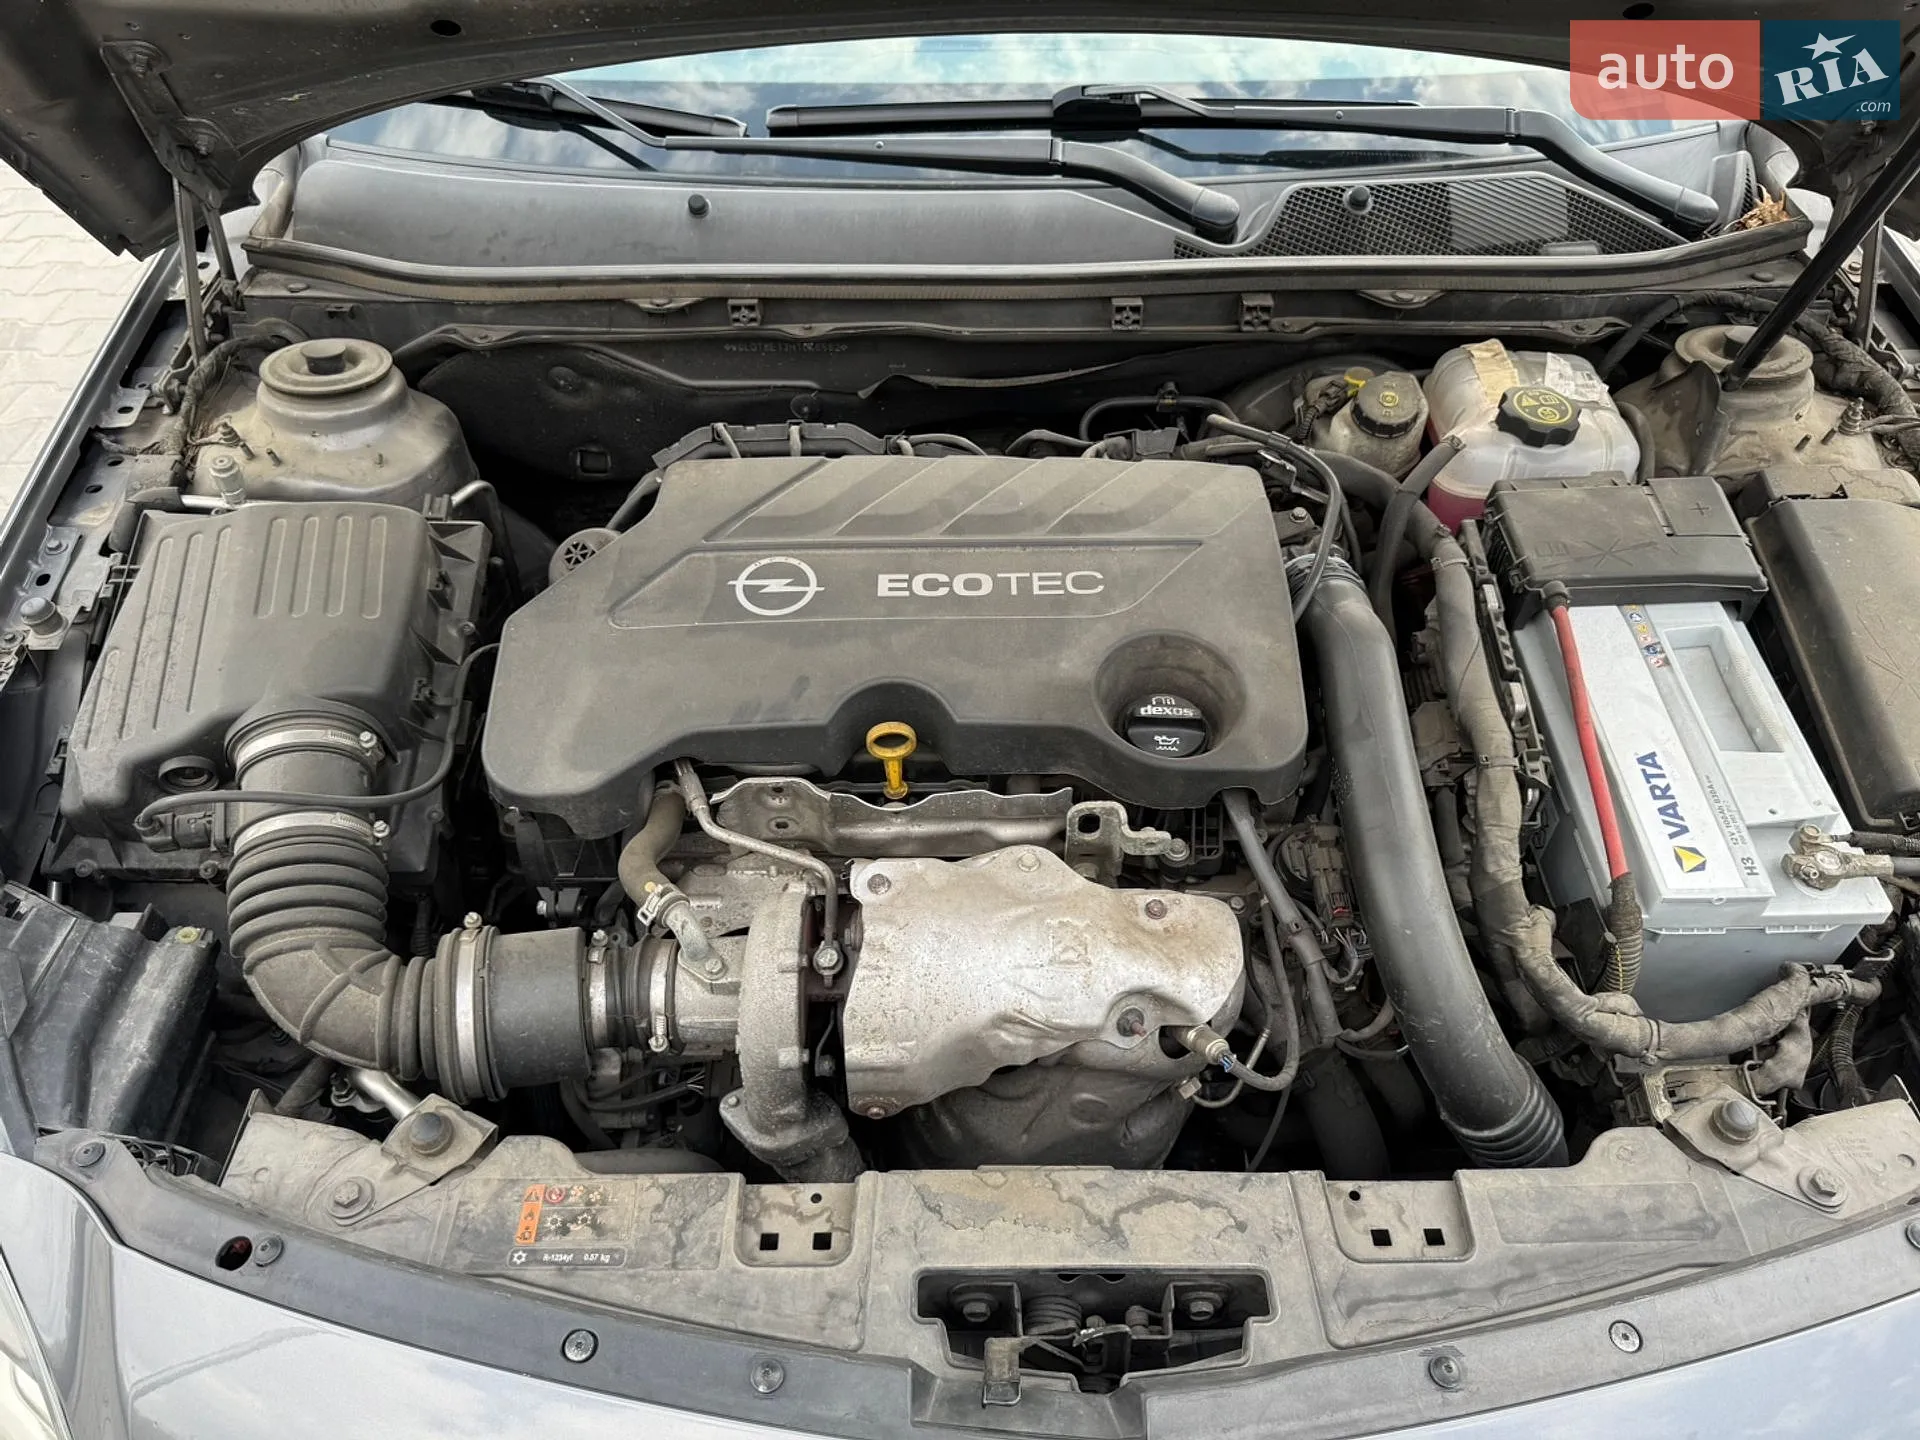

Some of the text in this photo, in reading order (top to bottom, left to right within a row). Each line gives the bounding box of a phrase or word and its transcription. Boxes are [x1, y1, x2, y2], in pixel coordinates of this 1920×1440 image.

[877, 571, 1105, 597] ECOTEC
[1140, 704, 1194, 717] dexos
[1636, 751, 1690, 840] VARTA
[1741, 856, 1760, 876] H3
[600, 1253, 611, 1264] kg
